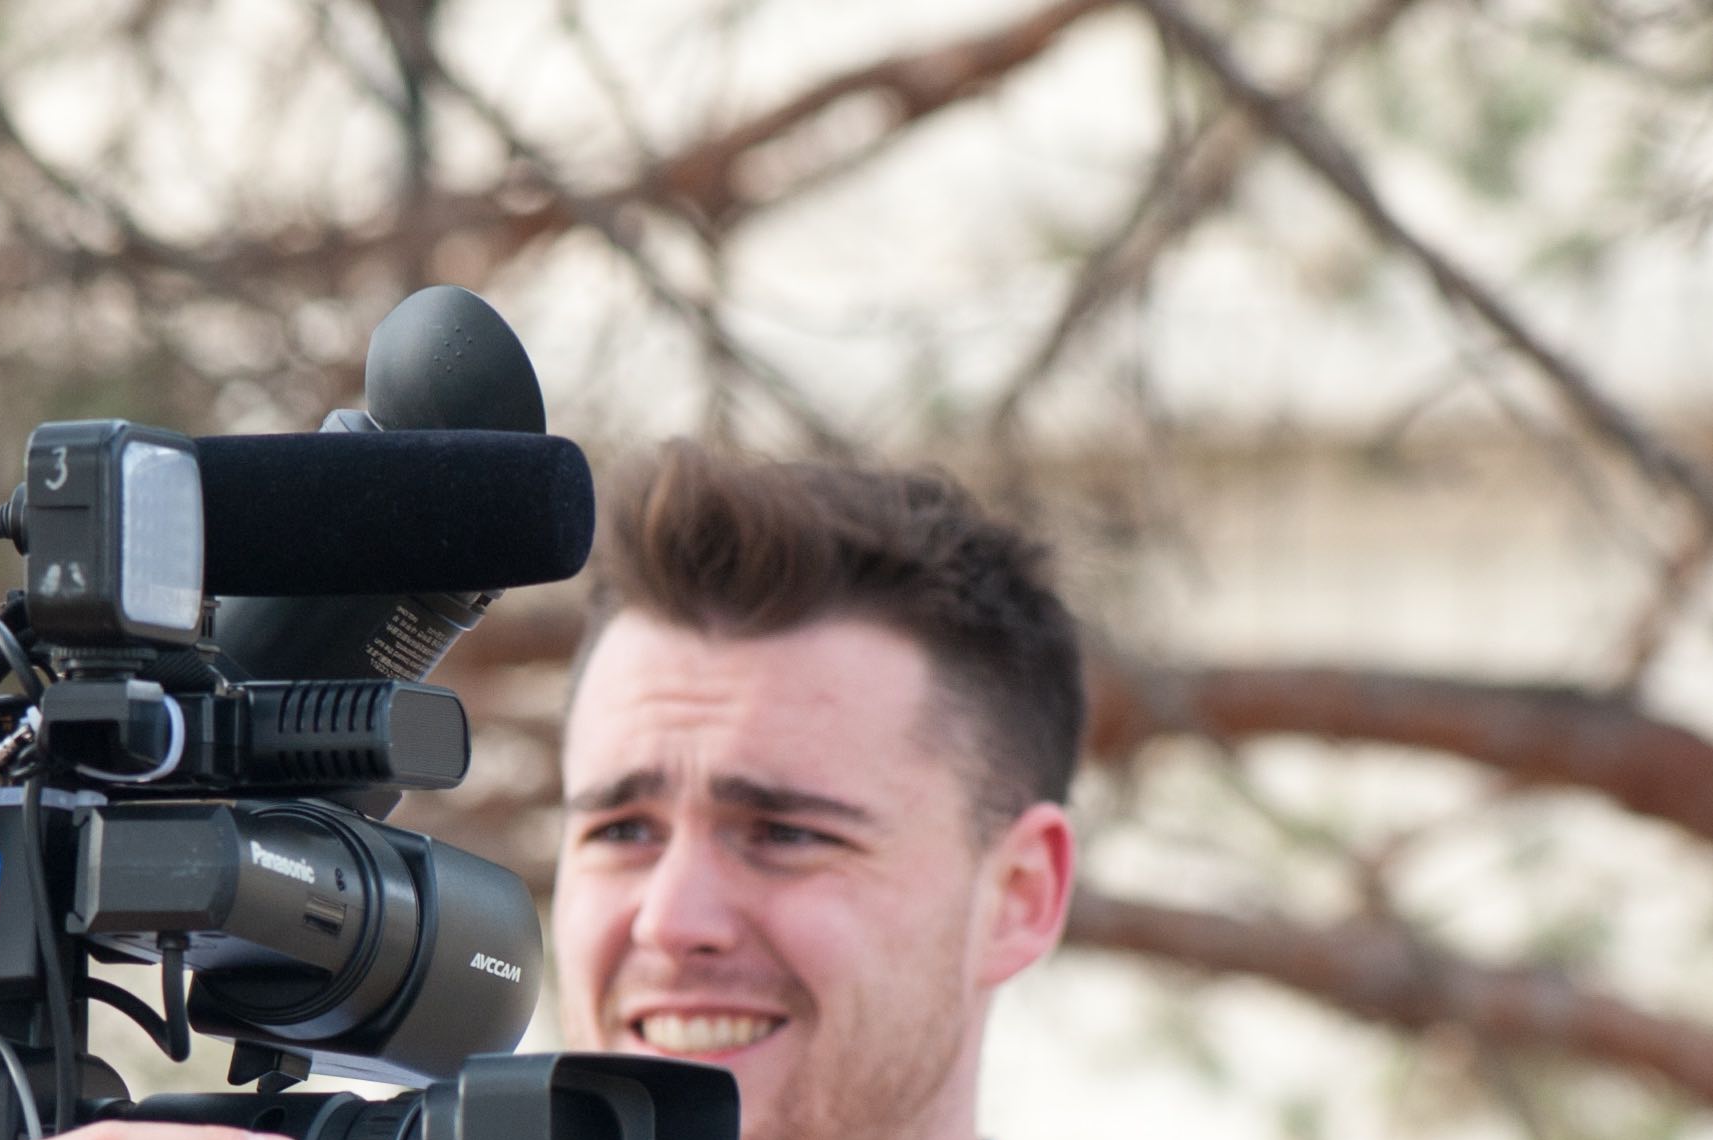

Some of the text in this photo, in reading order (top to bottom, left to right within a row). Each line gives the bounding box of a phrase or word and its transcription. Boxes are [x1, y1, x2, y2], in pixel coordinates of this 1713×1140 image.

[44, 446, 68, 491] 3
[250, 840, 316, 884] Panasonic
[470, 952, 522, 983] AVCCAM
